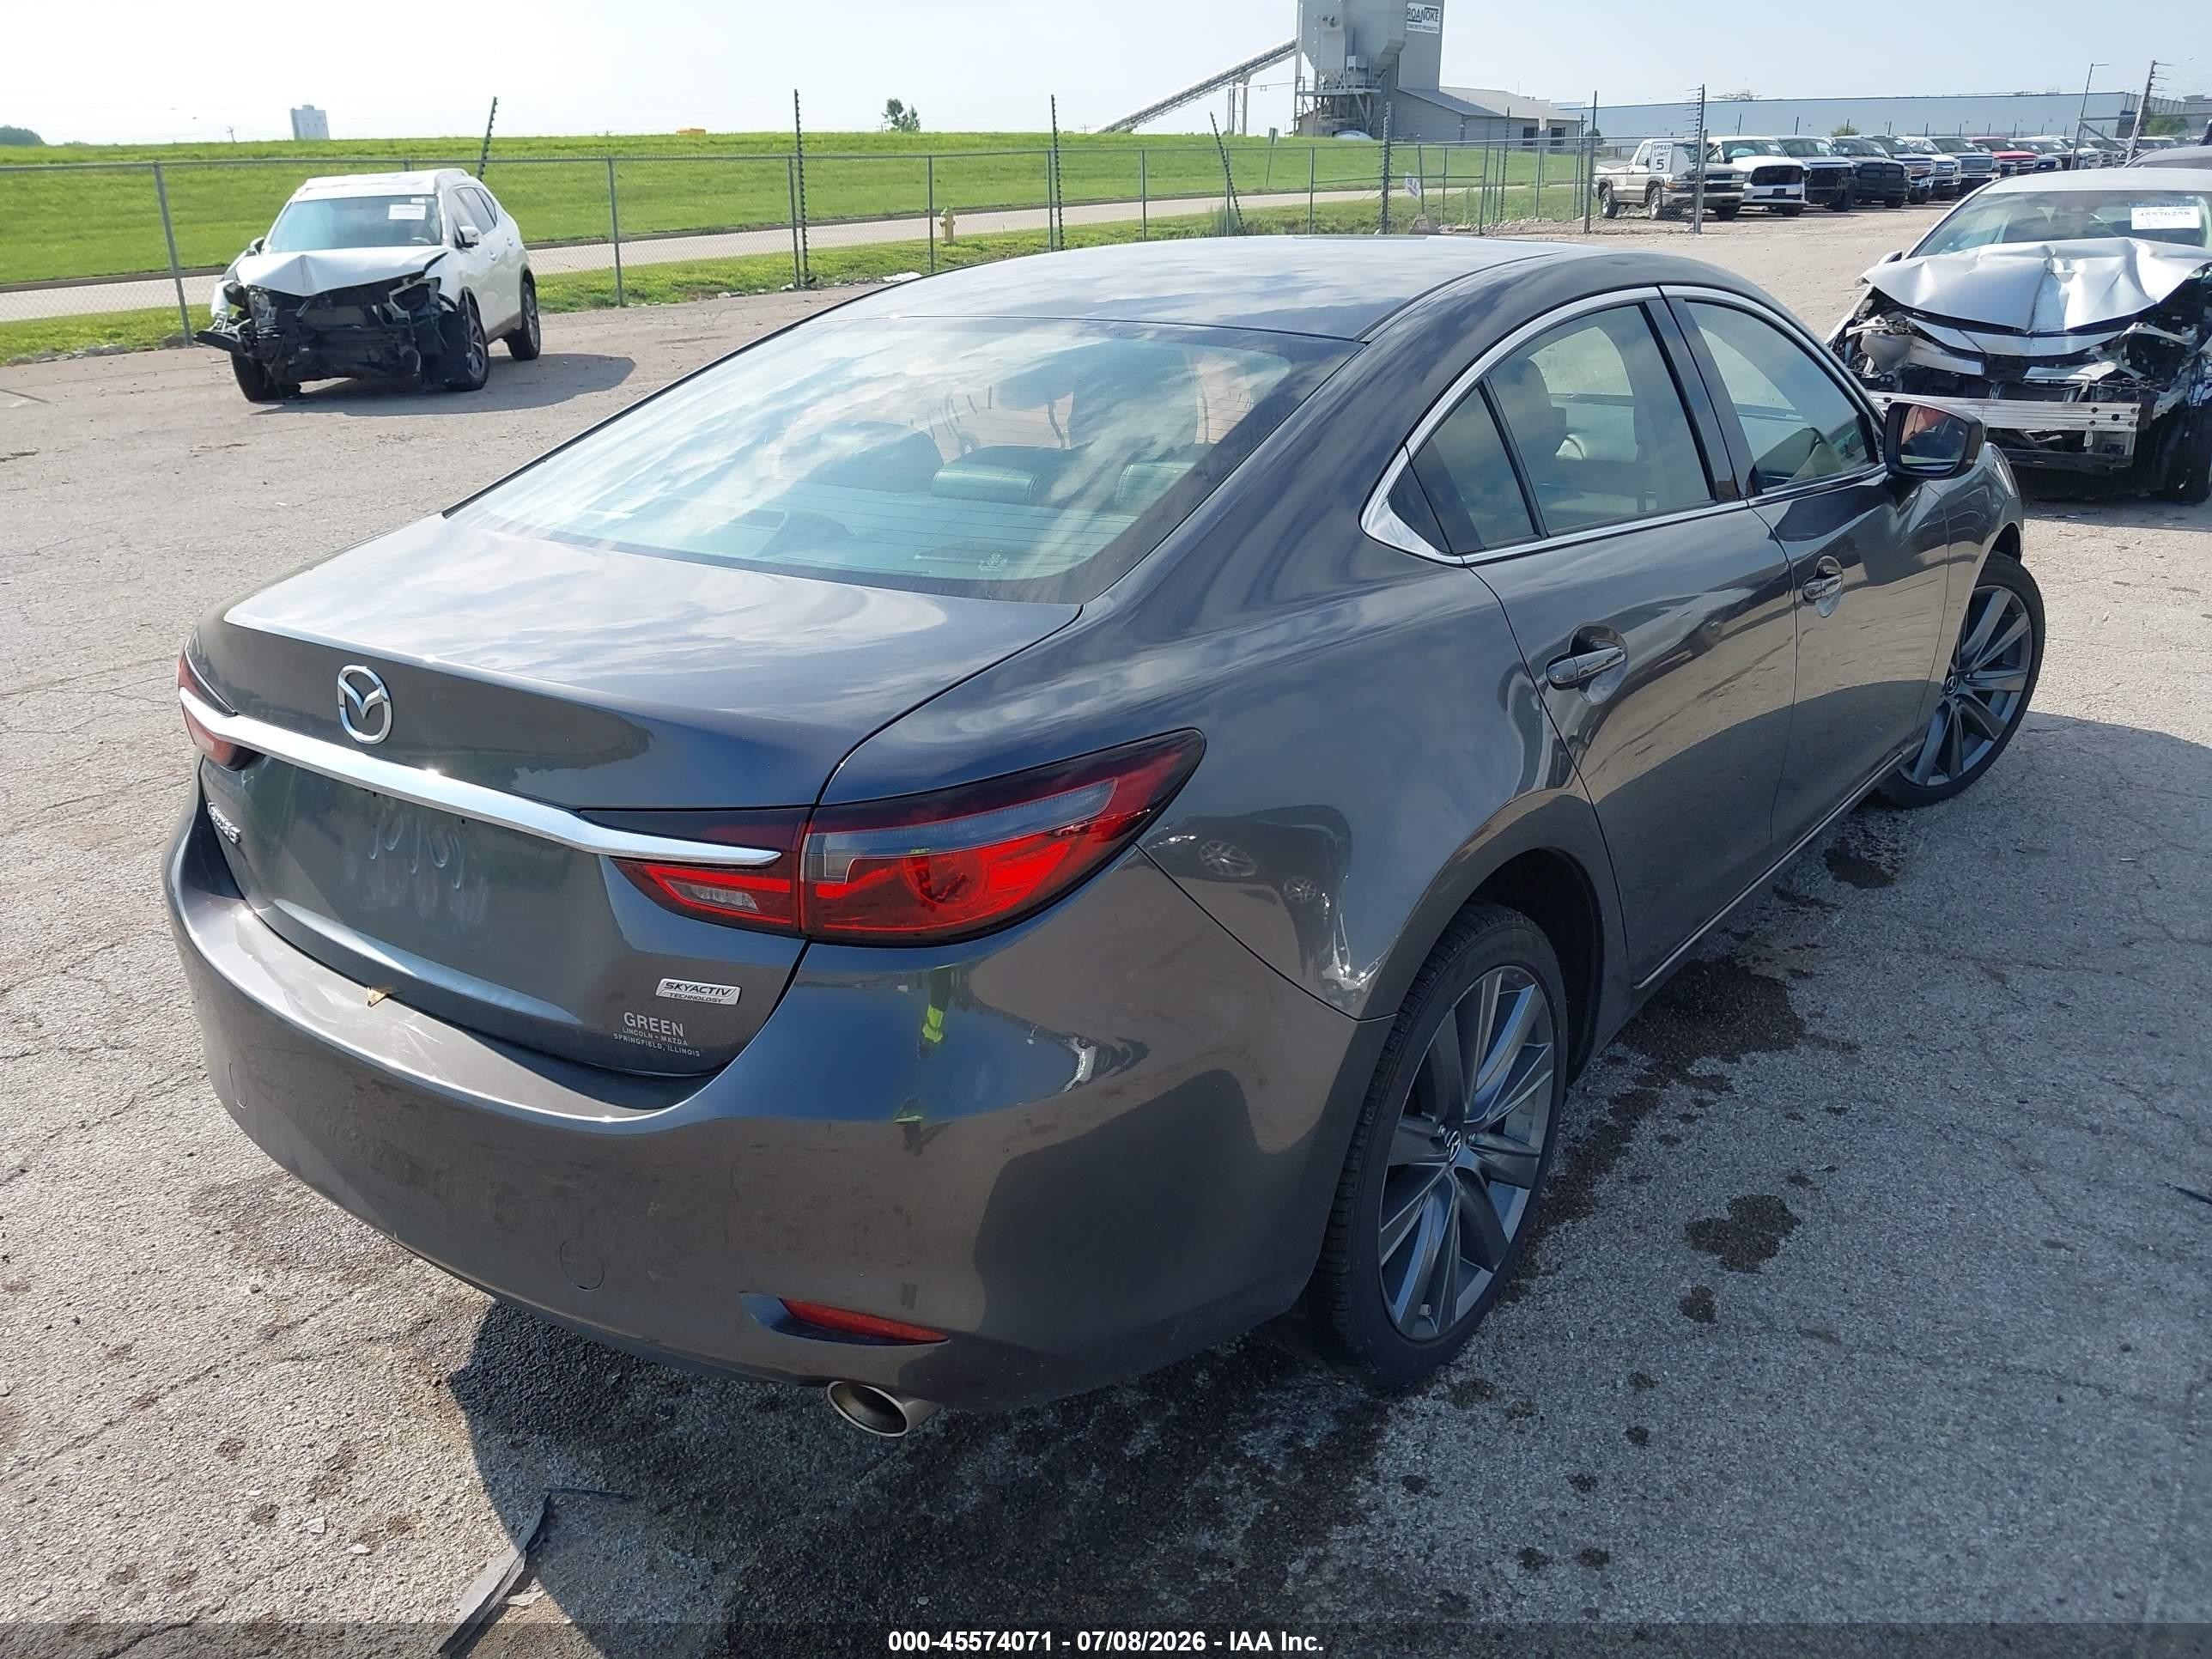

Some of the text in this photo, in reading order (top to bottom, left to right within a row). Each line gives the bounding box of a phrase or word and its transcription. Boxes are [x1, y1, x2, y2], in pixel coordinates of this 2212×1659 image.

[1407, 8, 1439, 22] ROANOKE
[1656, 158, 1664, 170] 5
[664, 981, 732, 996] SKYACTIV
[669, 992, 724, 1003] TECHNOLOGY
[623, 1012, 684, 1037] GREEN
[622, 1027, 688, 1046] LINCOLN MAZDA
[613, 1032, 701, 1057] SPRINGFIELD, ILLINOIS
